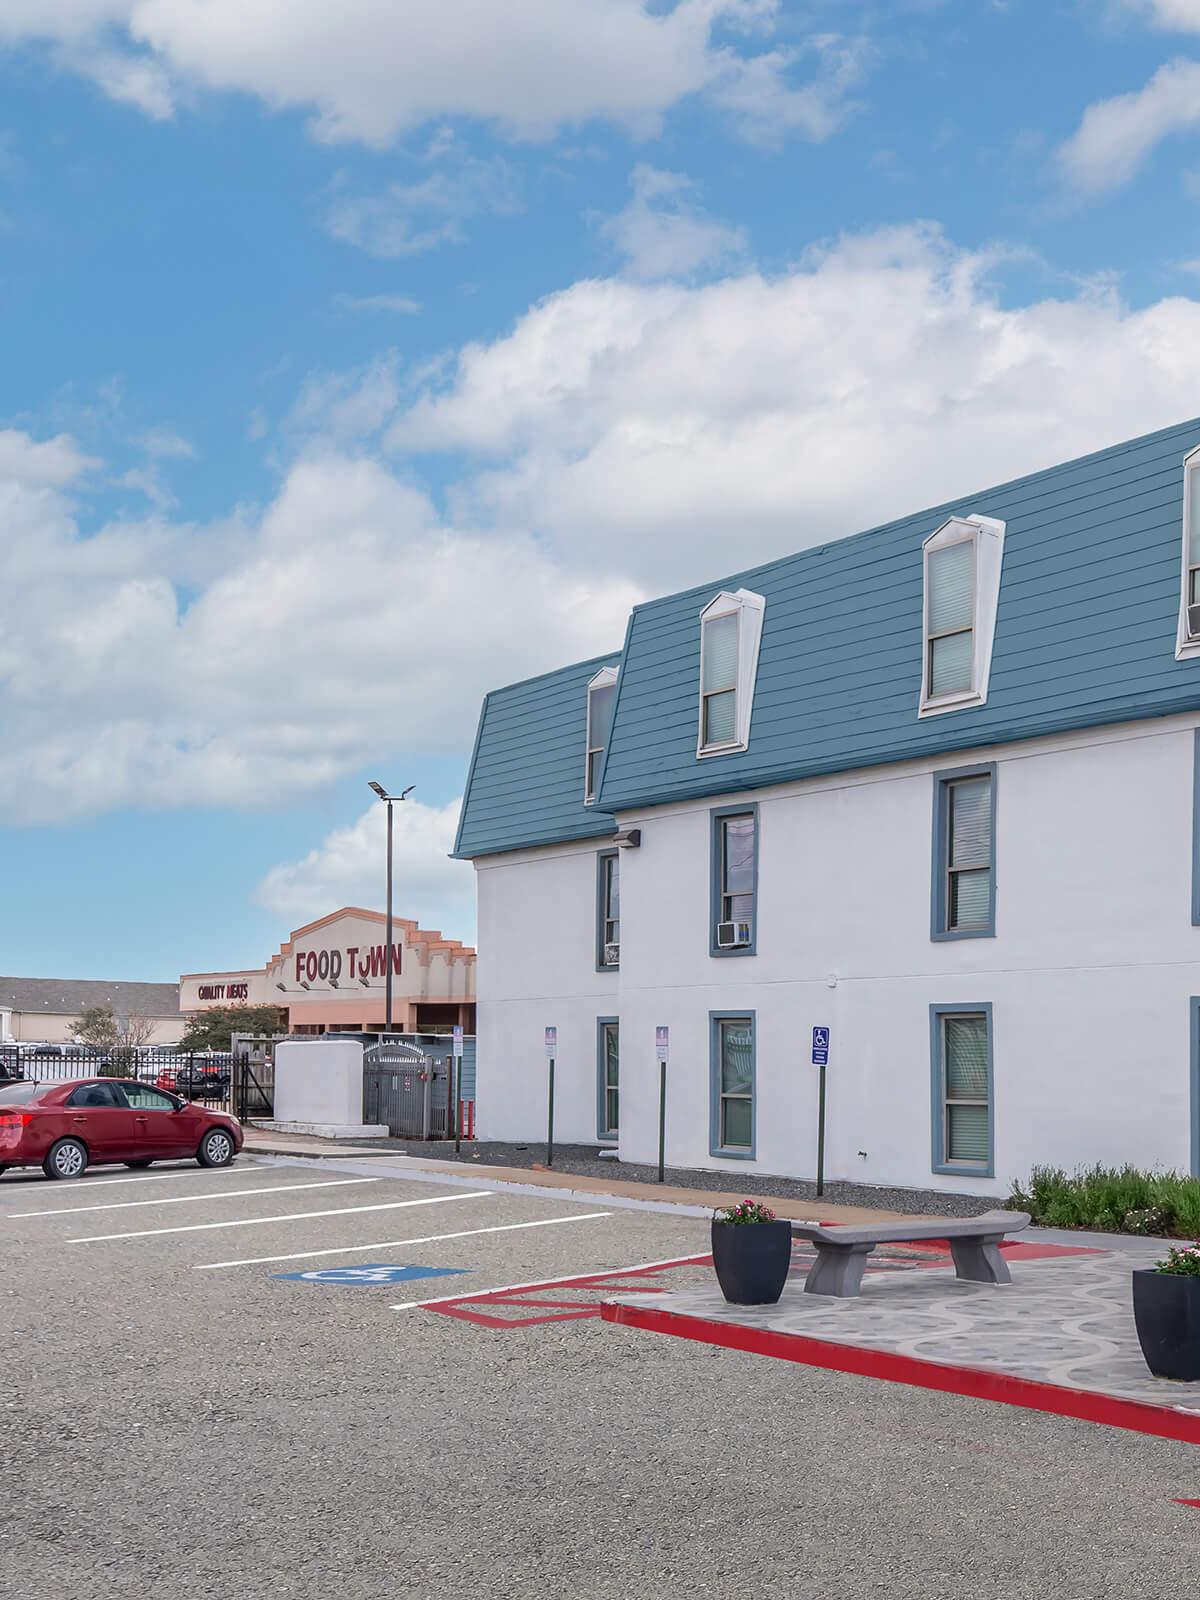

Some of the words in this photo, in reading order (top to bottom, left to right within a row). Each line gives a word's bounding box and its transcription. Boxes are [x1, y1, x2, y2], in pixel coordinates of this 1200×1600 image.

[296, 950, 342, 982] FOOD
[347, 943, 402, 979] TOWN
[199, 985, 225, 1000] QUALITY
[227, 984, 248, 999] MEATS
